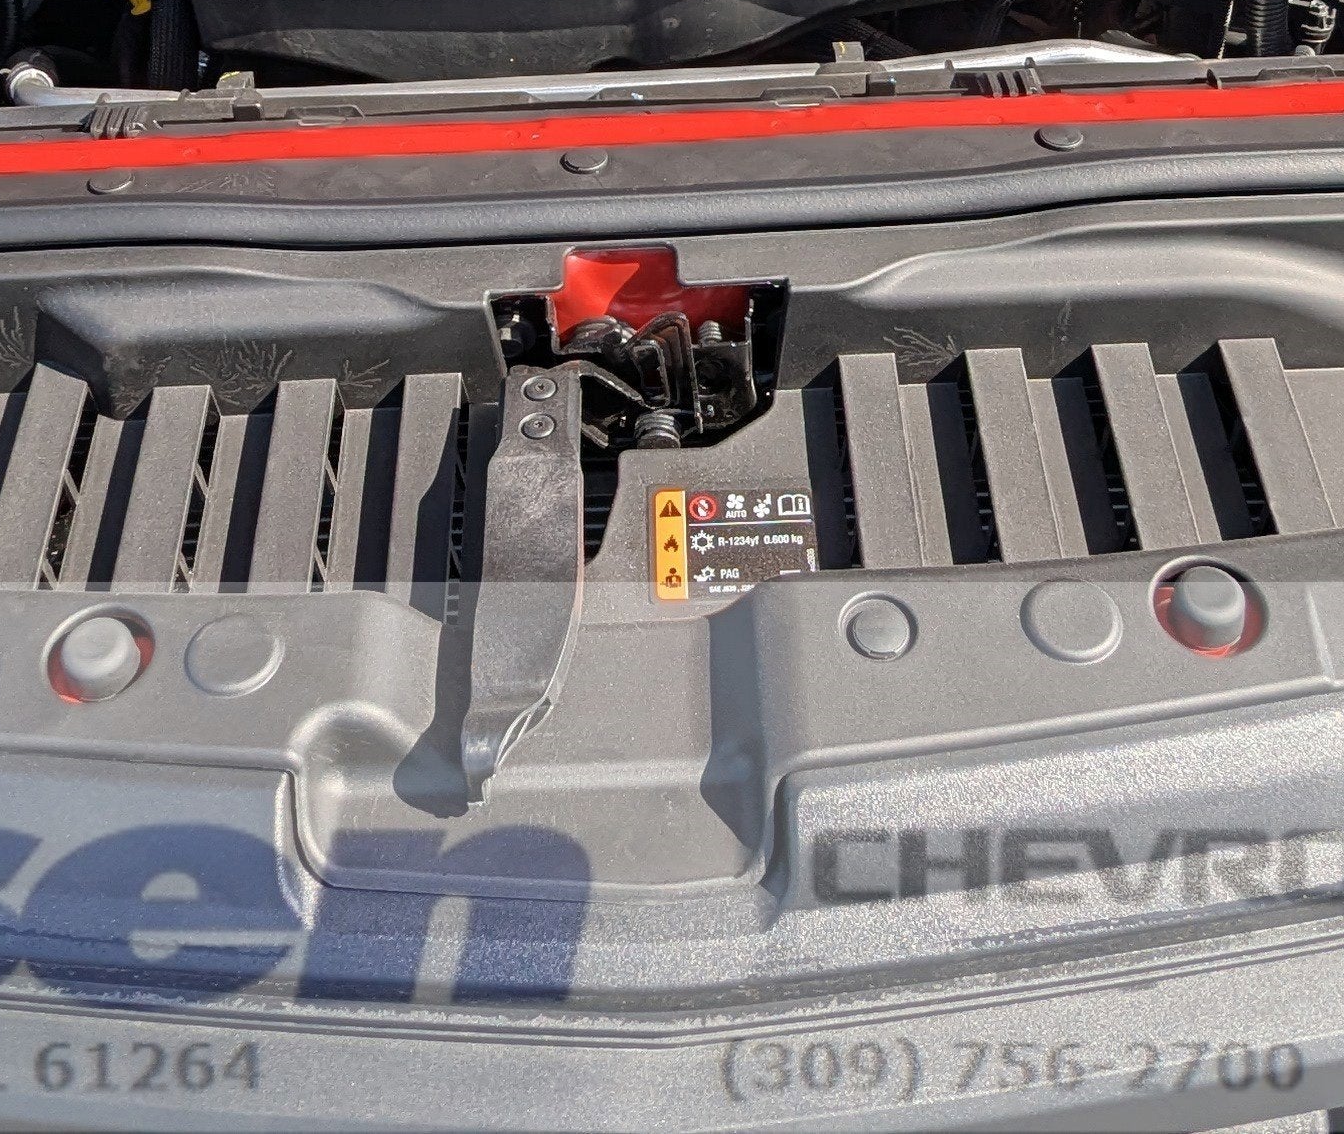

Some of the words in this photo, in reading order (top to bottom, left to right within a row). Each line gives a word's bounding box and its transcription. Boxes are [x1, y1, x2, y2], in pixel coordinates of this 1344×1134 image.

[725, 510, 747, 519] AUTO
[717, 536, 759, 547] R-1234yf
[790, 534, 804, 545] kg
[720, 568, 740, 579] PAG
